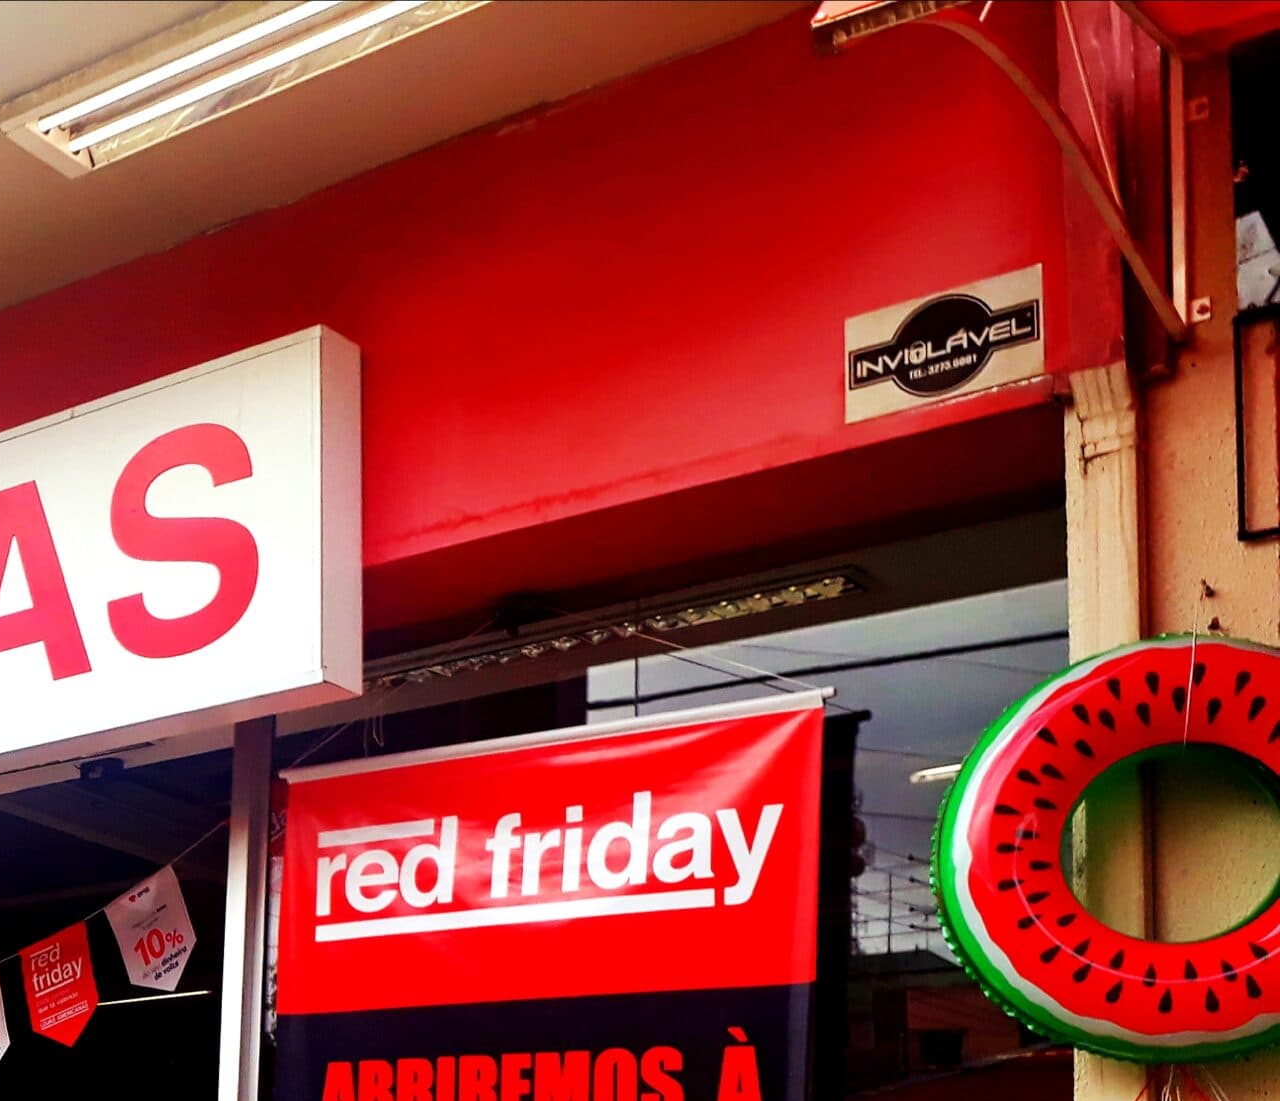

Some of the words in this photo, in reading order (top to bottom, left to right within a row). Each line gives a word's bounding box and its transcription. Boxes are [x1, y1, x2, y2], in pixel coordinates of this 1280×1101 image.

[856, 317, 1032, 378] INVIOLÁVEL
[315, 815, 459, 917] red
[485, 790, 784, 906] friday
[31, 943, 61, 971] red
[134, 928, 184, 967] 10%
[32, 957, 83, 992] friday
